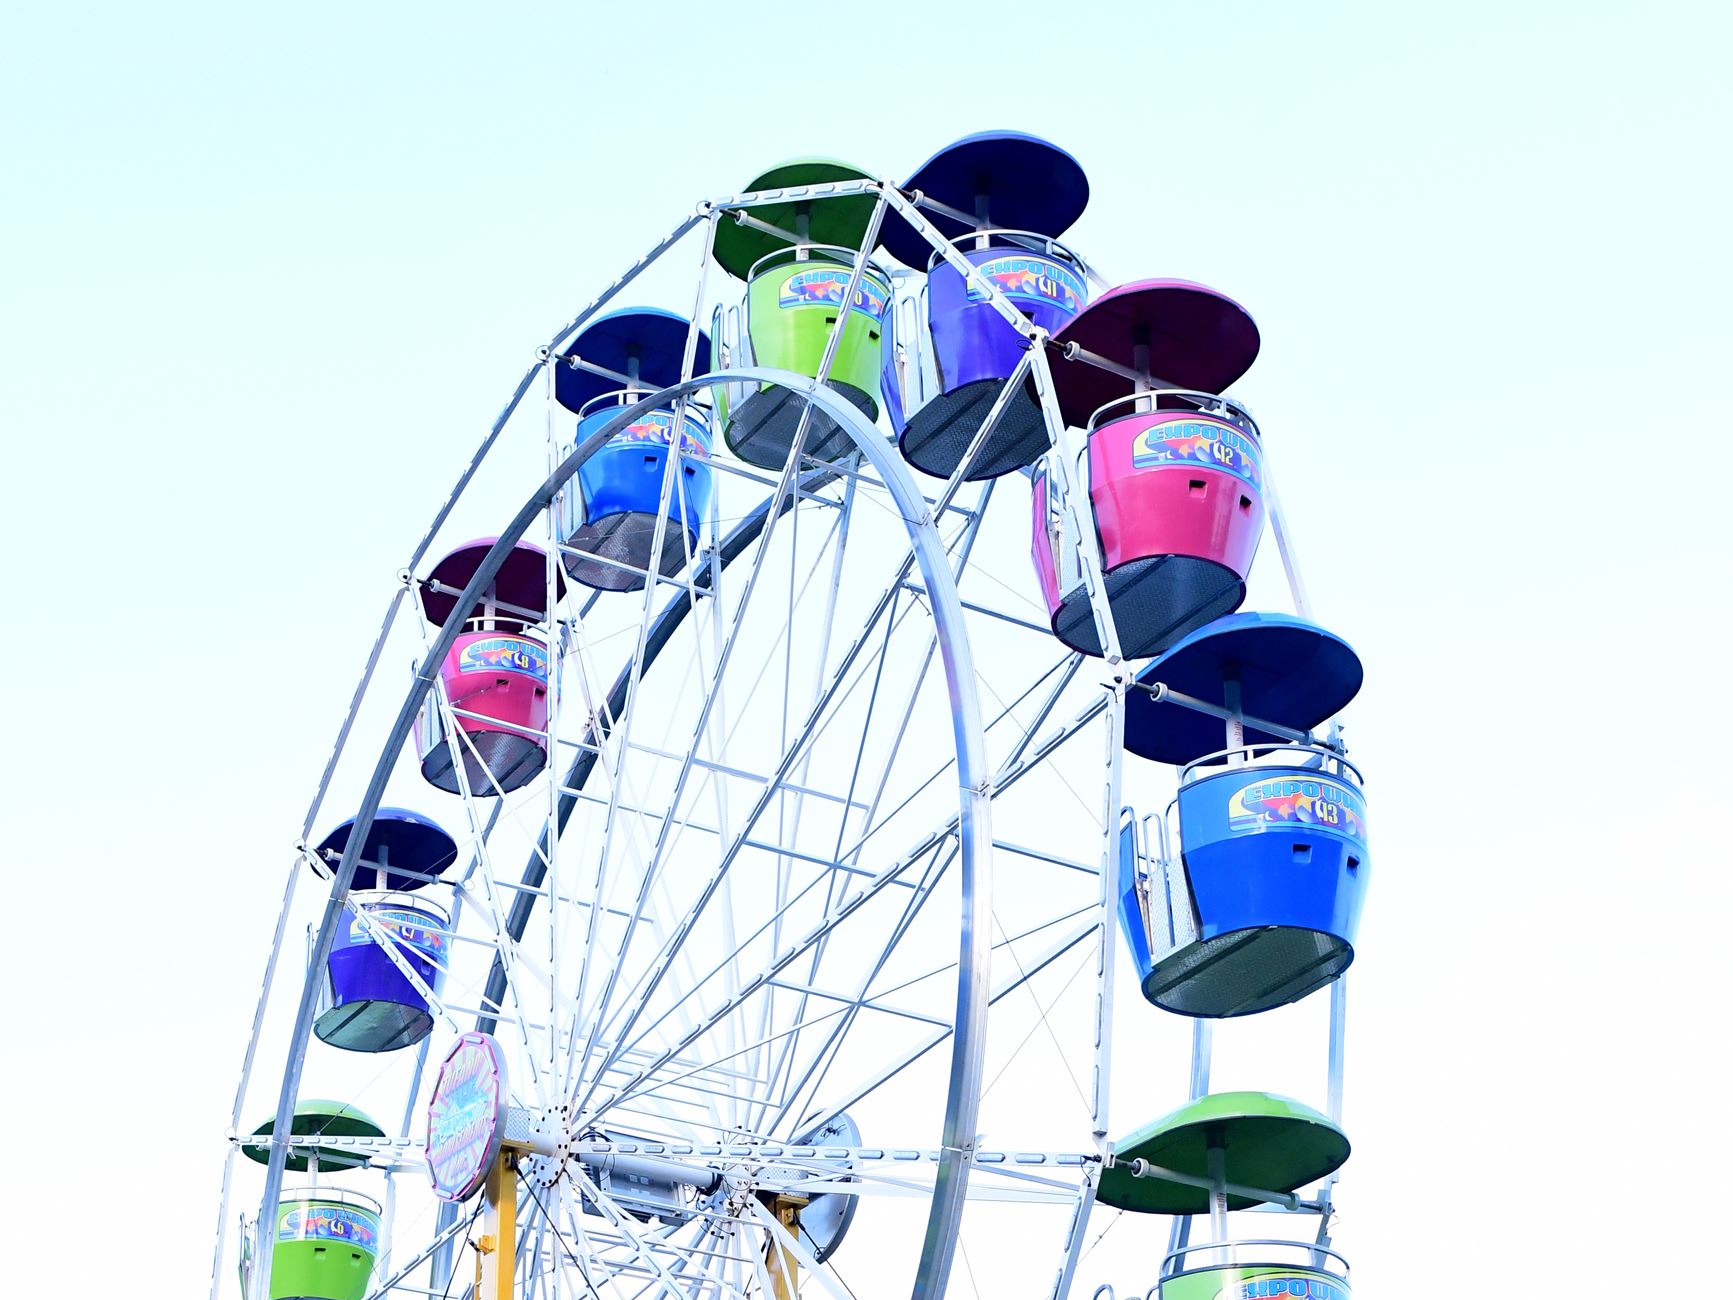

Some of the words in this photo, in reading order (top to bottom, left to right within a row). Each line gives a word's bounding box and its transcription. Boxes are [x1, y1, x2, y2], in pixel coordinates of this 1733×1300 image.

[1148, 424, 1218, 444] EXPO
[1219, 445, 1234, 466] 12
[1244, 782, 1320, 804] EXPO
[1321, 803, 1338, 824] 13
